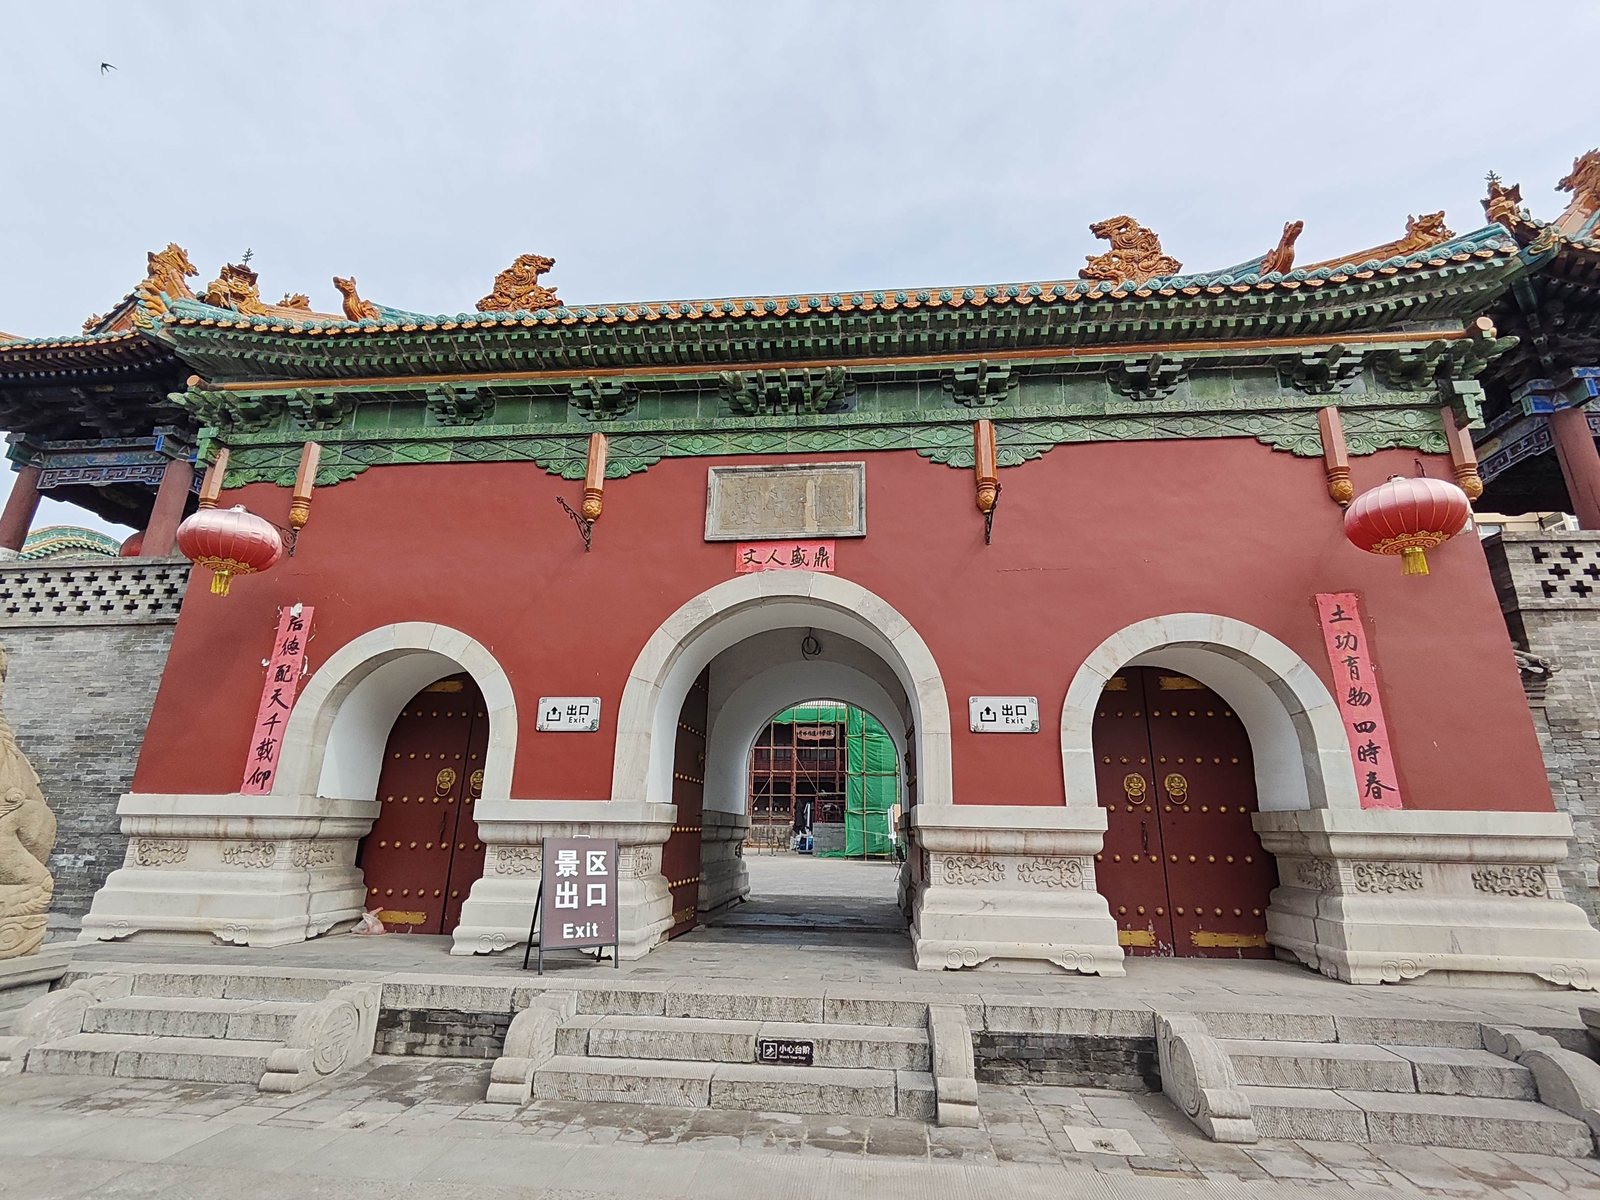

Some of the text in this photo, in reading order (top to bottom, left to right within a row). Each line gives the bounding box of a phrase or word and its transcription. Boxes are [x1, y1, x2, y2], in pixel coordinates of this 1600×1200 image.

[566, 704, 590, 716] 出口
[1001, 704, 1027, 716] 出口
[568, 716, 586, 724] Exit
[1005, 716, 1024, 724] Exit
[554, 849, 609, 878] 景区
[554, 880, 608, 910] 出口
[562, 922, 599, 939] Exit
[778, 1044, 811, 1055] 小心台阶
